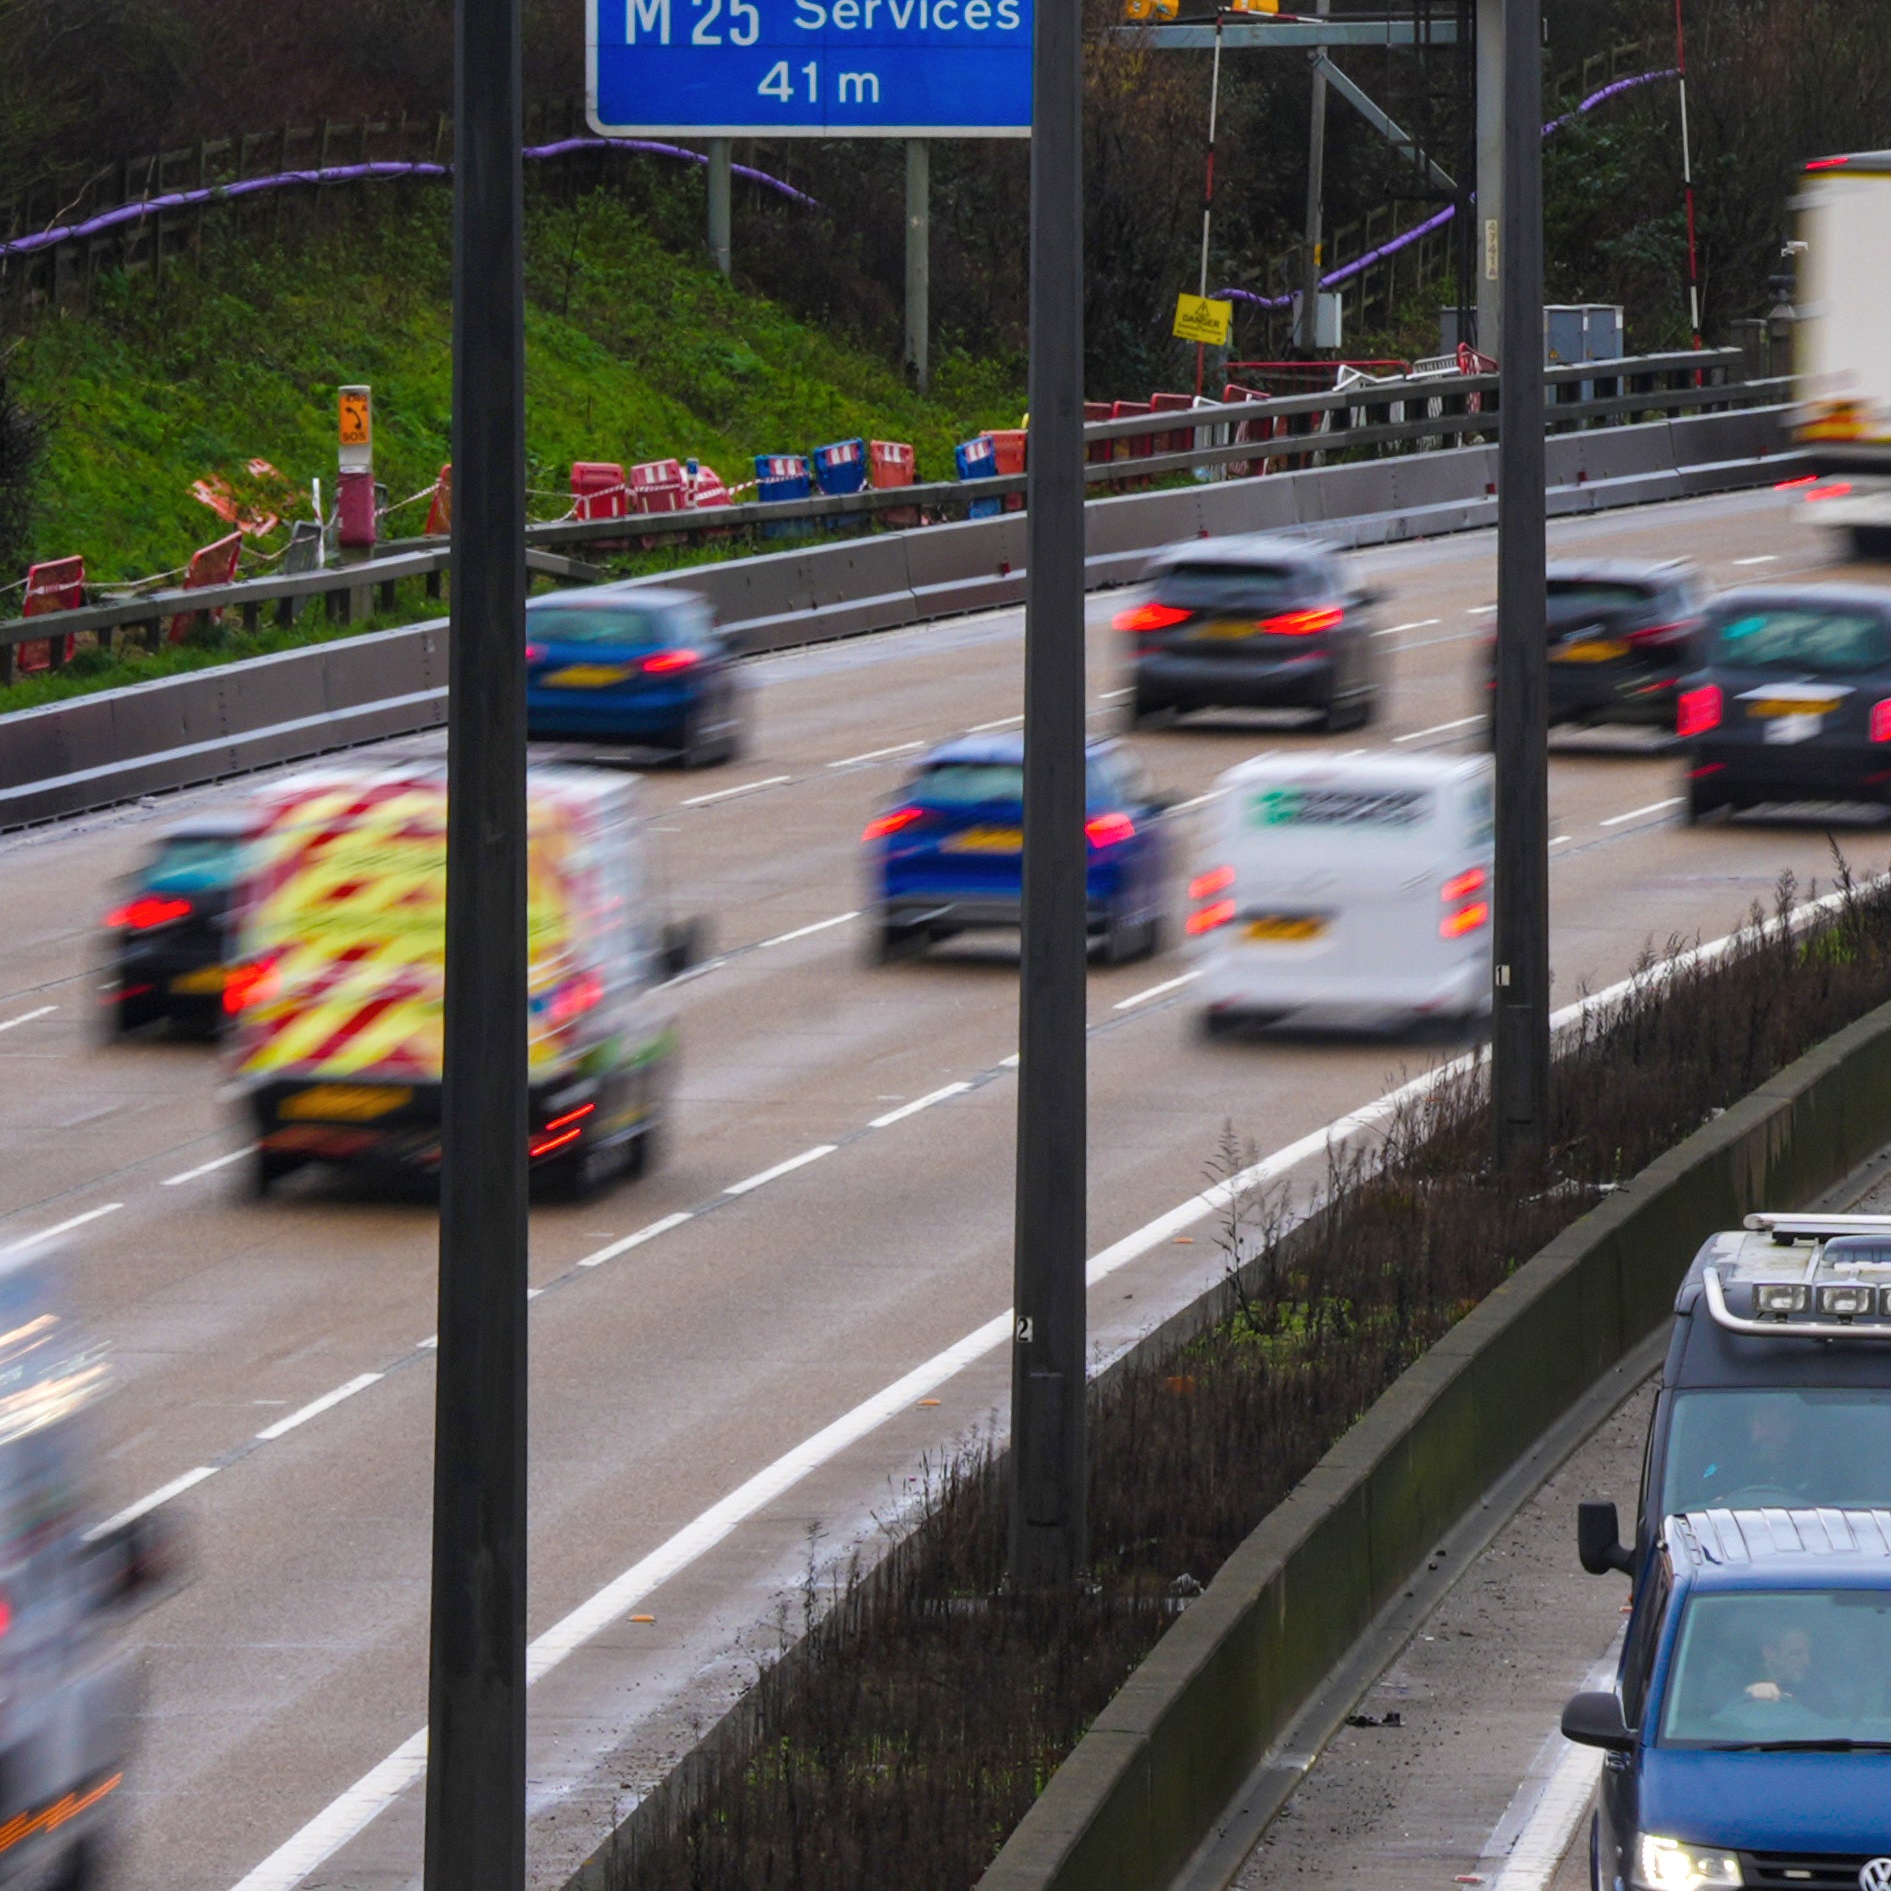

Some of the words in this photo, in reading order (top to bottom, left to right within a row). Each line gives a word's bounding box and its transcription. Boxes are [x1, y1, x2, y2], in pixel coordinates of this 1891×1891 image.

[757, 61, 817, 103] 41
[838, 72, 880, 103] m
[1018, 1317, 1028, 1341] 2
